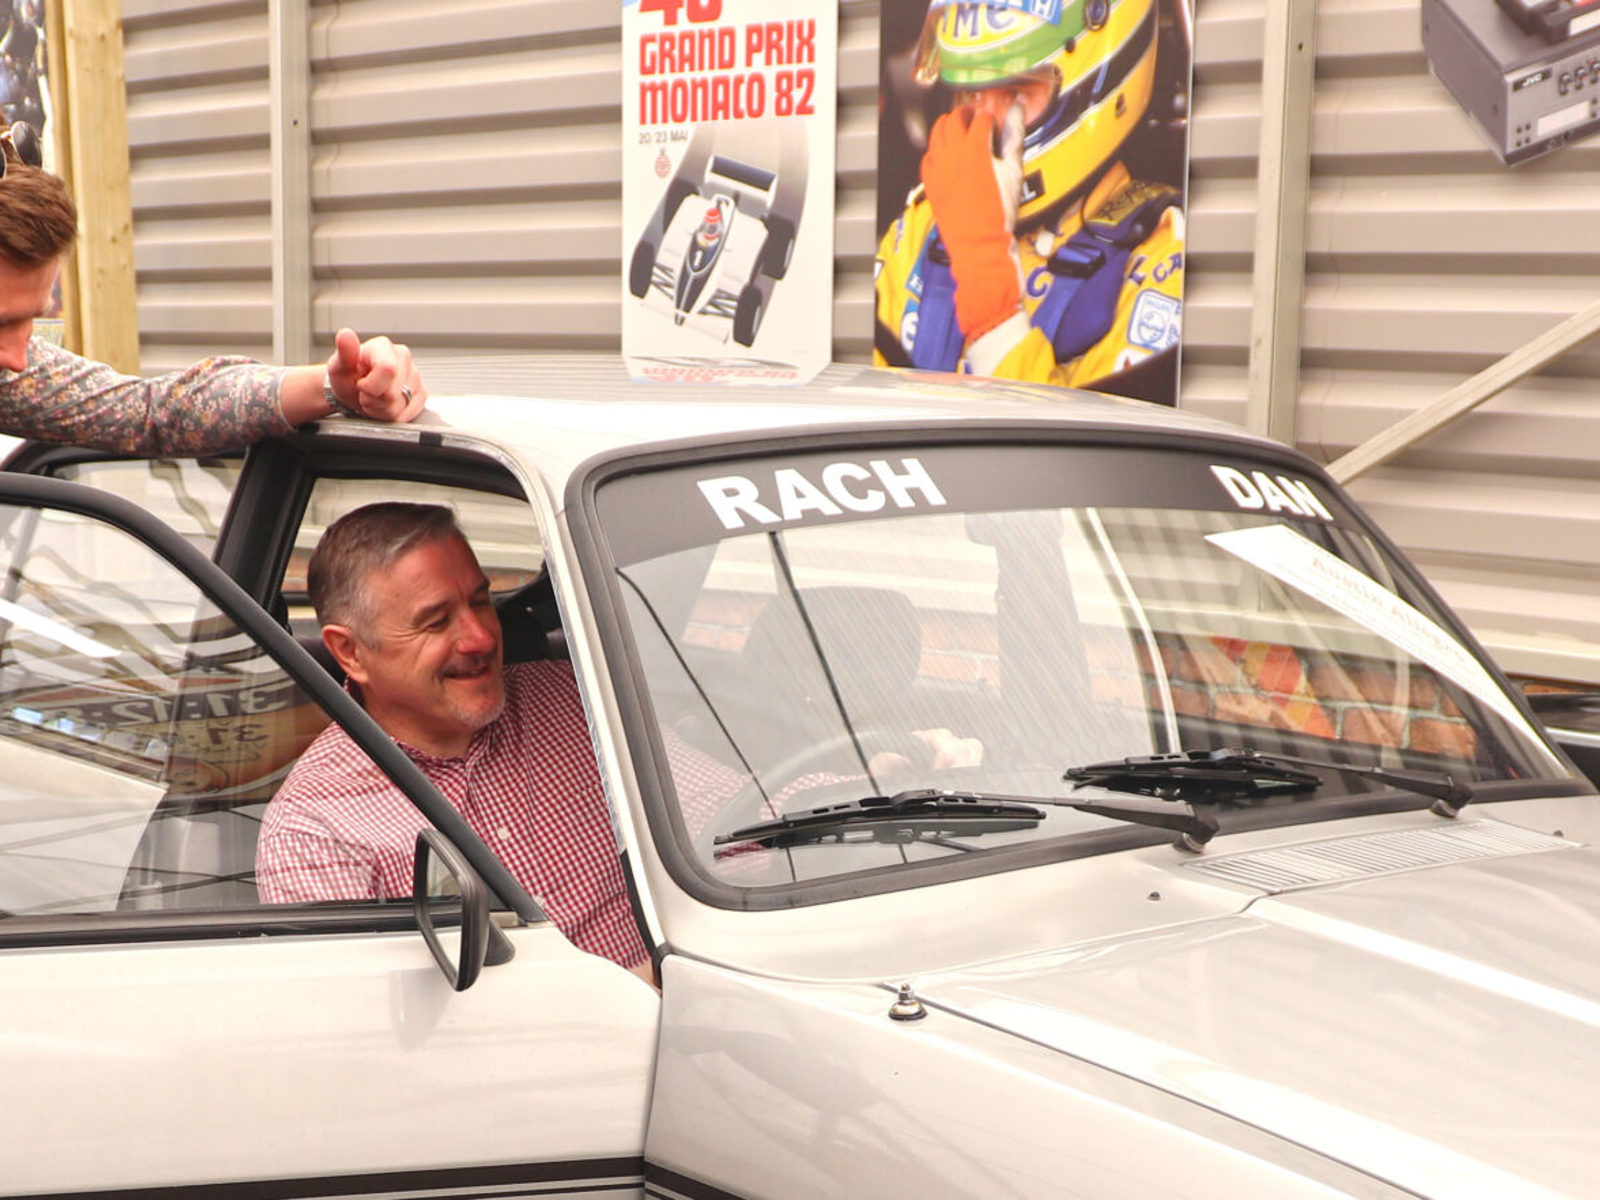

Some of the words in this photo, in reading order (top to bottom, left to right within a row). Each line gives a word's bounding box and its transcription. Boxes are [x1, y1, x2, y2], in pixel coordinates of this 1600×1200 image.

[639, 26, 736, 76] GRAND
[745, 18, 815, 67] PRIX
[639, 72, 766, 125] MONACO
[775, 68, 815, 117] 82
[697, 458, 947, 530] RACH
[1210, 465, 1334, 521] DAN
